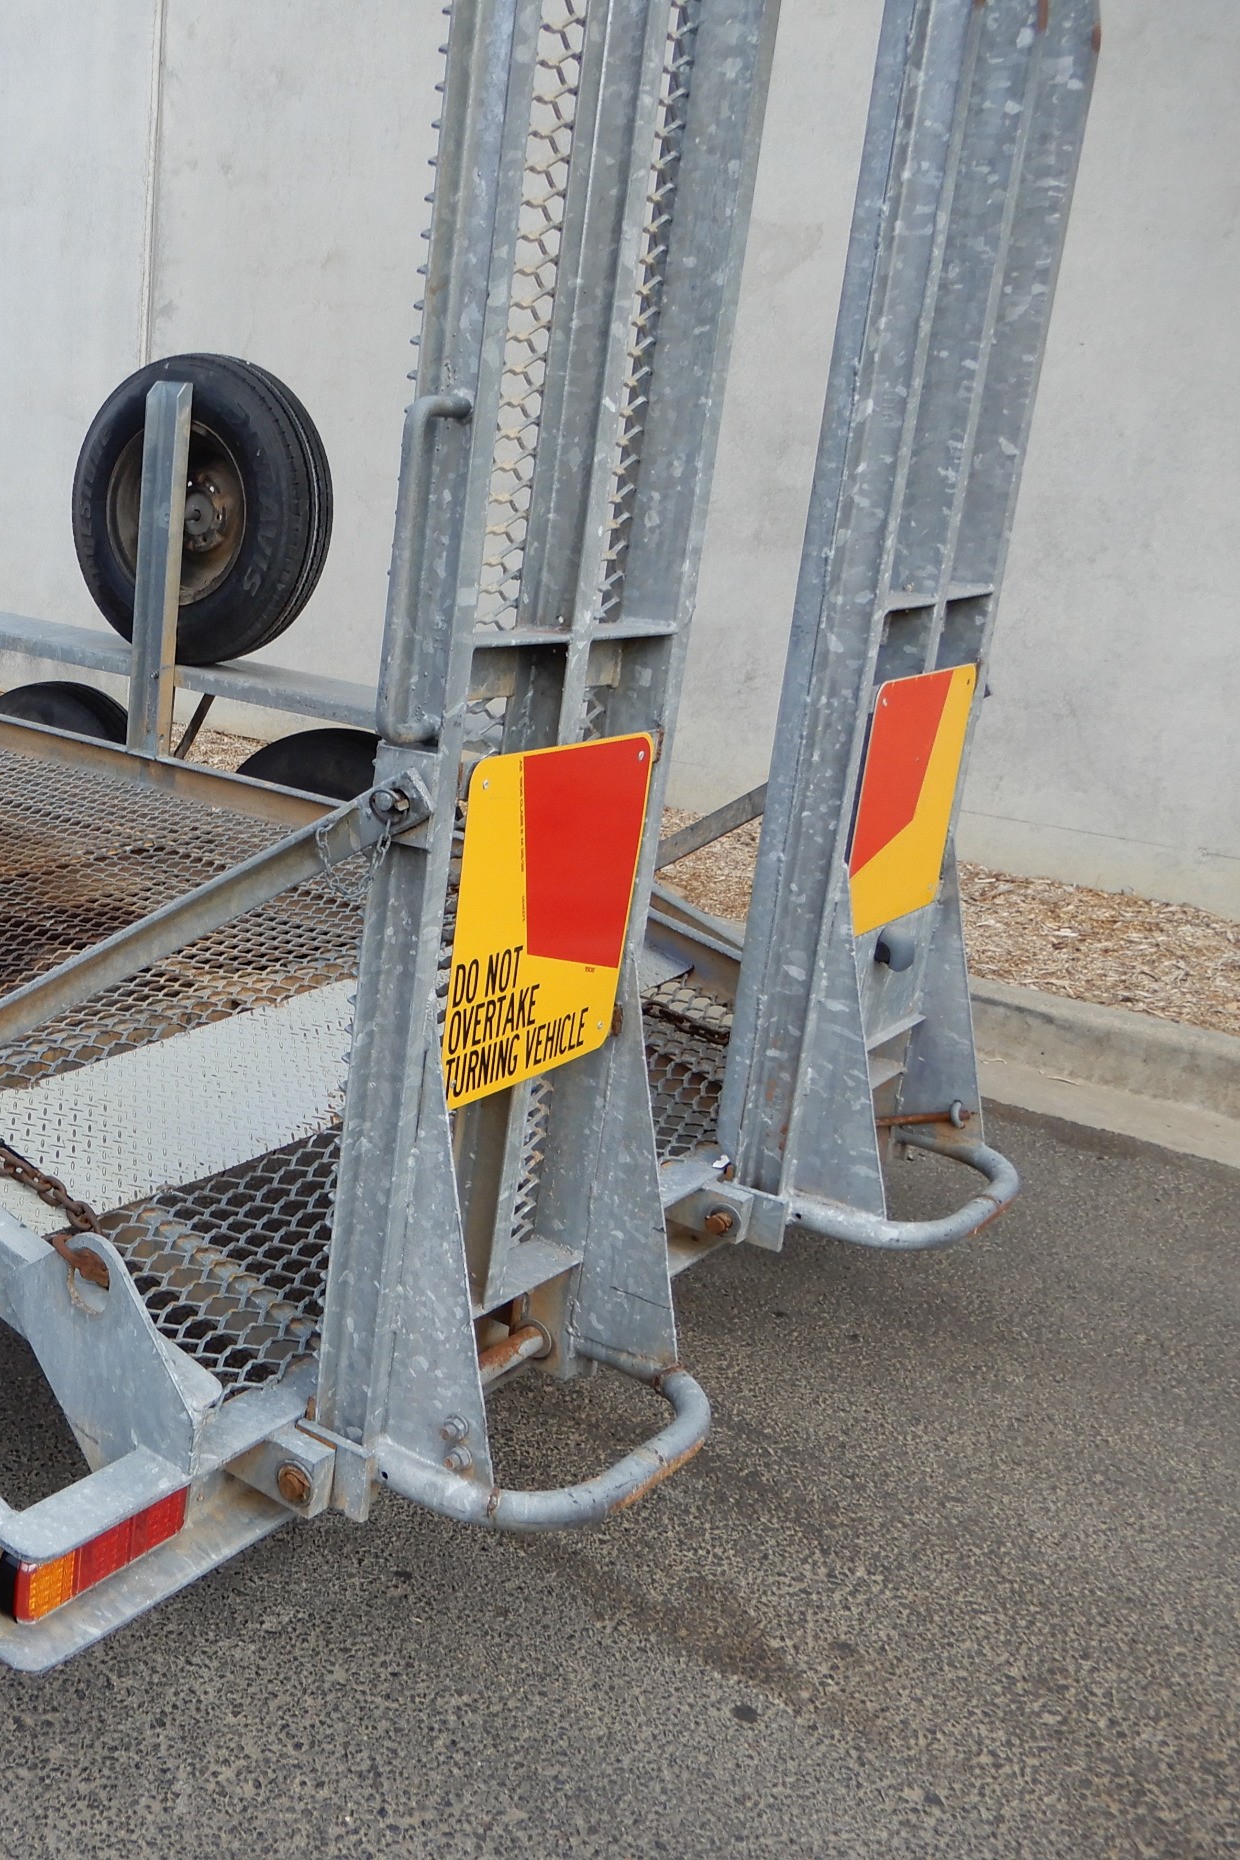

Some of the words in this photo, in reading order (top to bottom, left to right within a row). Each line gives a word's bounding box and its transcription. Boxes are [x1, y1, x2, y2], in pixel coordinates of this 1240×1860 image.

[452, 958, 480, 1009] DO
[484, 944, 524, 998] NOT
[445, 1033, 521, 1101] TURNING
[524, 1006, 590, 1070] VEHICLE
[448, 983, 541, 1056] OVERTAKE
